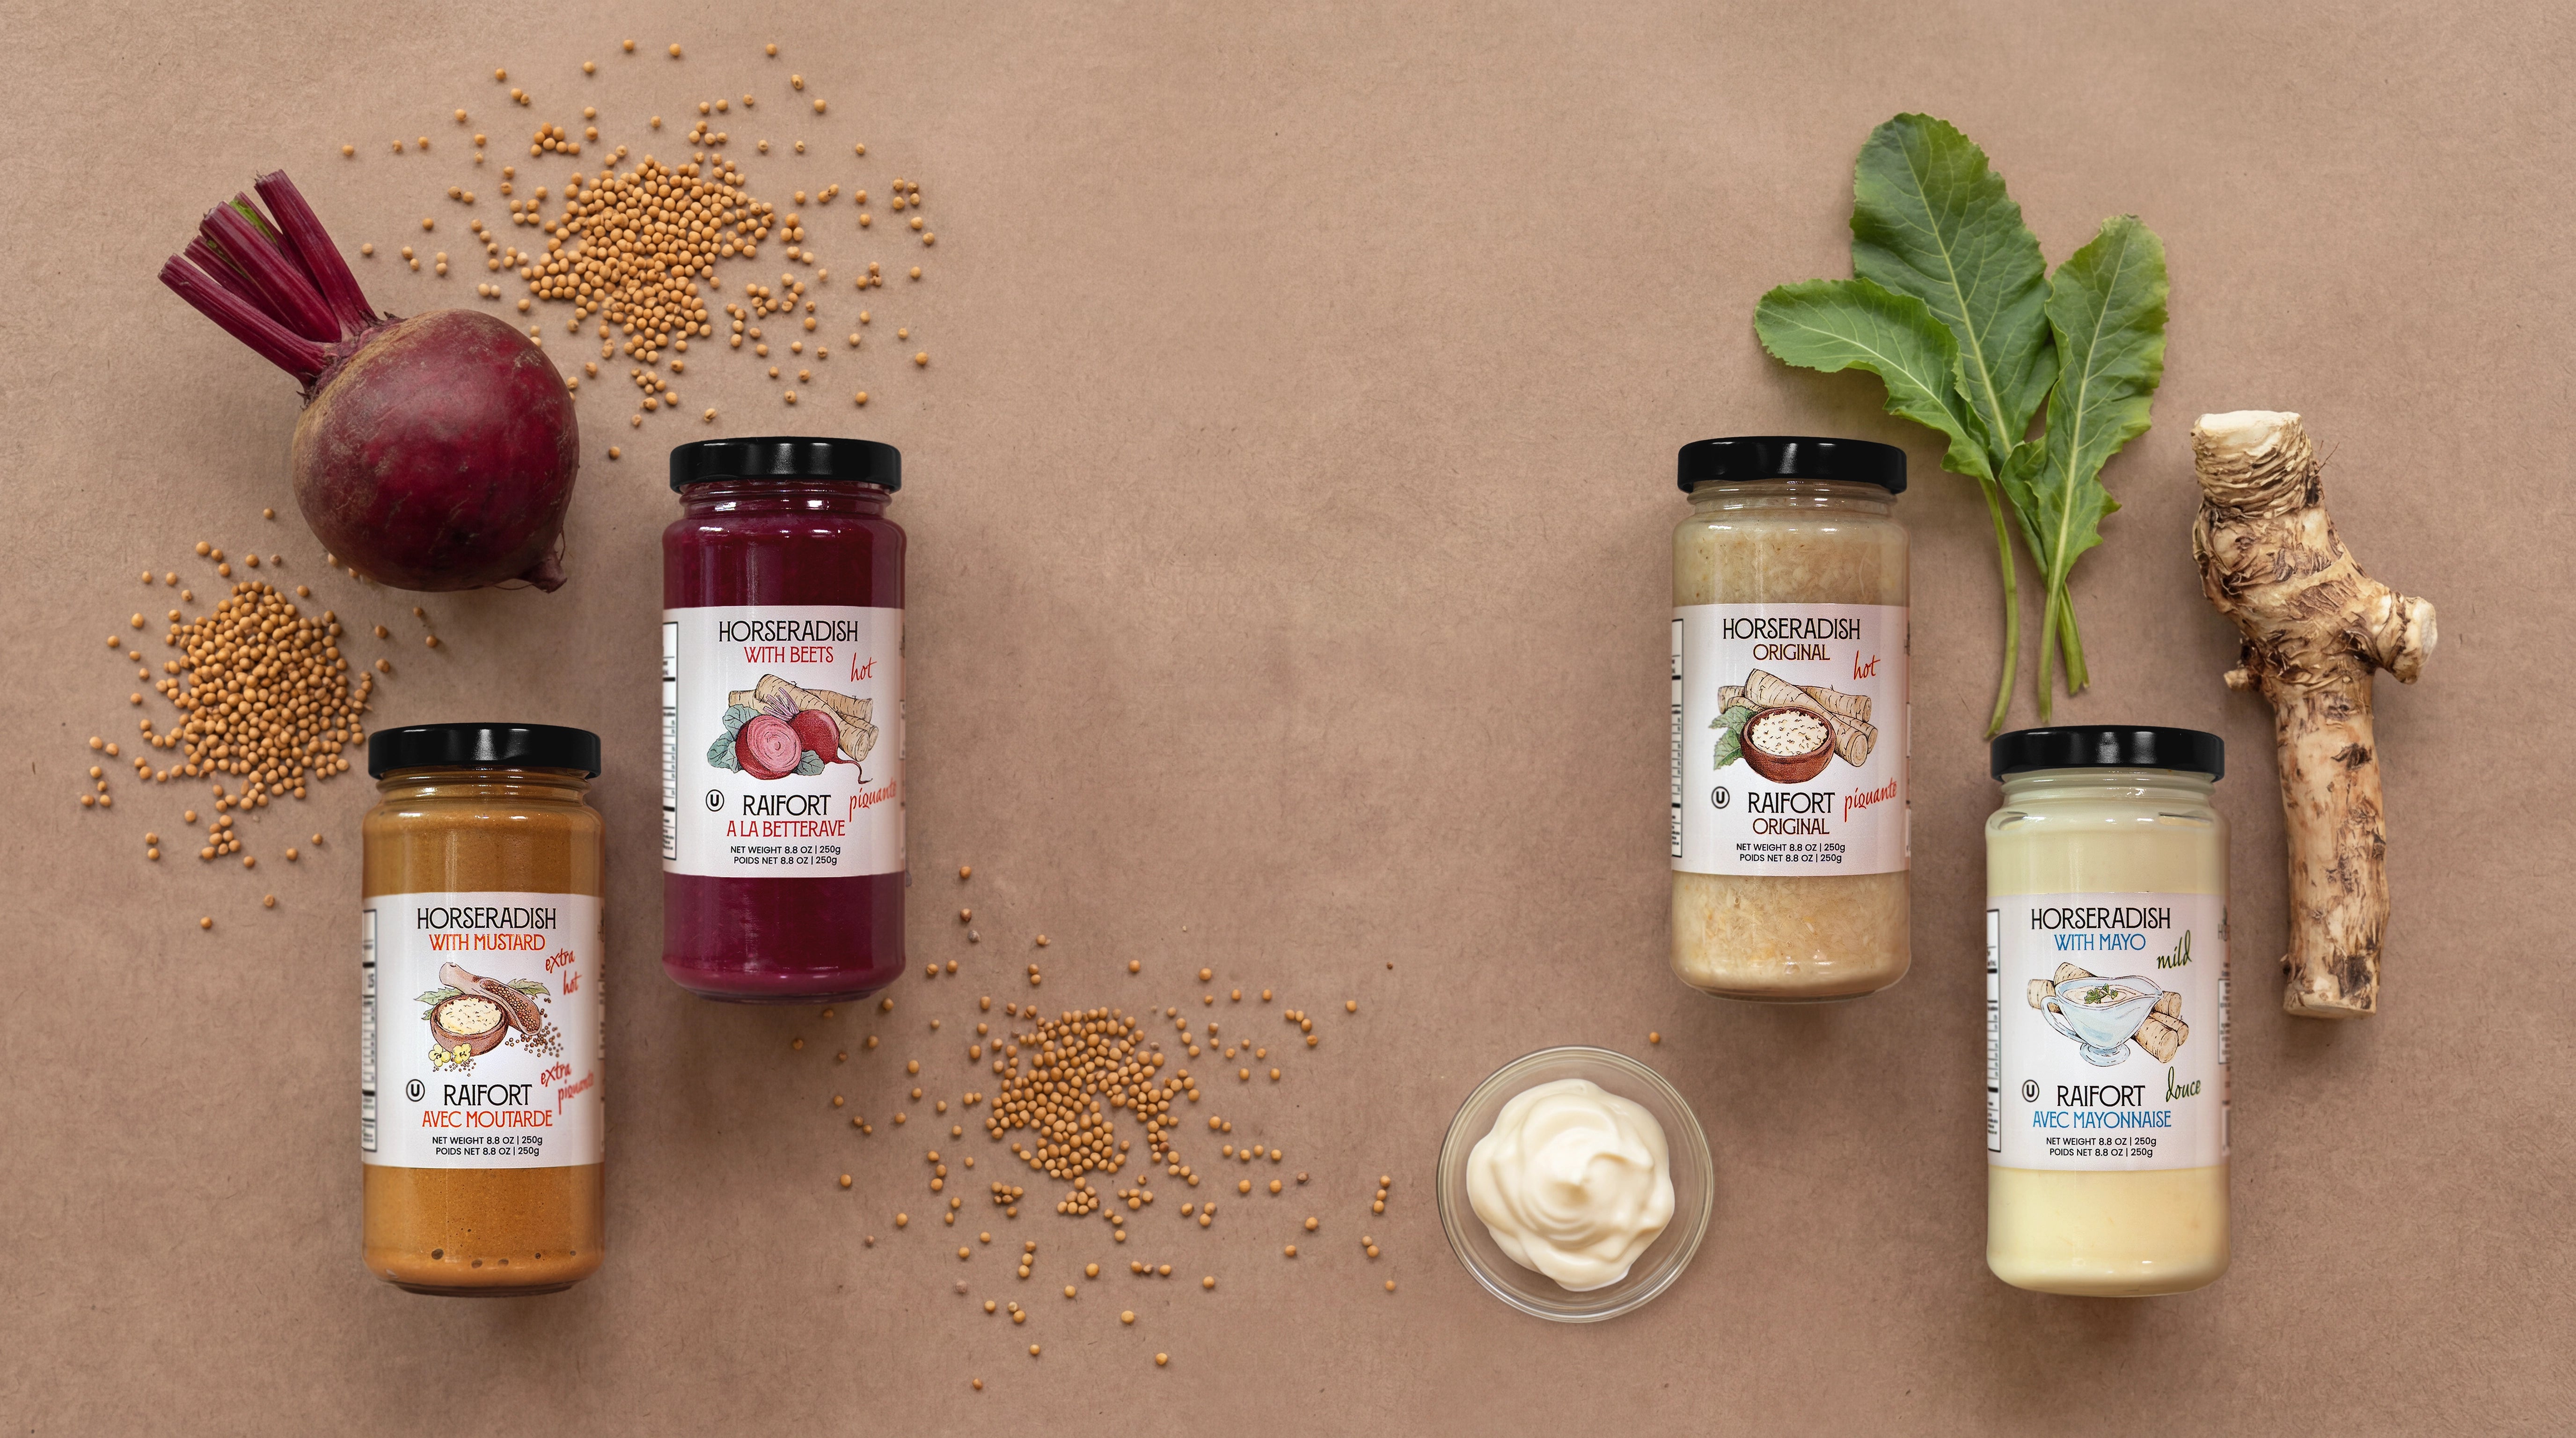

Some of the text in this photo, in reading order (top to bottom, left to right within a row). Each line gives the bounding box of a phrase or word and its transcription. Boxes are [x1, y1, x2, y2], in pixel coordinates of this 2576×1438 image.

[719, 620, 858, 642] HORSERADISH
[1723, 617, 1860, 640] HORSERADISH
[744, 646, 834, 663] WITH BEETS
[1753, 643, 1830, 660] ORIGINAL
[850, 652, 877, 682] hot
[1853, 650, 1881, 680] hot
[743, 794, 832, 816] RAIFORT
[849, 776, 897, 823] piquante
[1748, 792, 1836, 814] RAIFORT
[1844, 777, 1897, 823] piquante
[726, 820, 846, 837] A LA BETTERAVE
[1752, 818, 1830, 835] ORIGINAL
[784, 846, 798, 854] 8.8
[819, 845, 841, 855] 250g
[1740, 853, 1765, 862] POIDS
[1785, 854, 1799, 862] 8.8
[1820, 853, 1842, 864] 250g
[1824, 843, 1845, 853] 250g
[734, 856, 760, 865] POIDS
[780, 856, 794, 865] 8.8
[815, 856, 837, 866] 250g
[417, 907, 556, 930] HORSERADISH
[2031, 907, 2171, 930] HORSERADISH
[428, 933, 546, 951] WITH MUSTARD
[2054, 933, 2146, 951] WITH MAYO
[2156, 929, 2192, 969] mild
[545, 948, 575, 974] extra
[563, 970, 582, 996] hot
[541, 1061, 572, 1087] extra
[2166, 1066, 2201, 1102] douce
[444, 1084, 533, 1106] RAIFORT
[2057, 1085, 2146, 1107] RAIFORT
[422, 1110, 553, 1128] AVEC MOUTARDE
[2033, 1110, 2172, 1129] AVEC MAYONNAISE
[432, 1136, 448, 1145] NET
[486, 1136, 500, 1145] 8.8
[502, 1136, 514, 1145] OZ
[521, 1136, 543, 1146] 250g
[436, 1147, 461, 1155] POIDS
[483, 1147, 496, 1155] 8.8
[518, 1146, 539, 1157] 250g
[2099, 1137, 2112, 1146] 8.8
[2134, 1137, 2157, 1147] 250g
[2049, 1148, 2074, 1156] POIDS
[2095, 1148, 2108, 1157] 8.8
[2130, 1148, 2153, 1158] 250g
